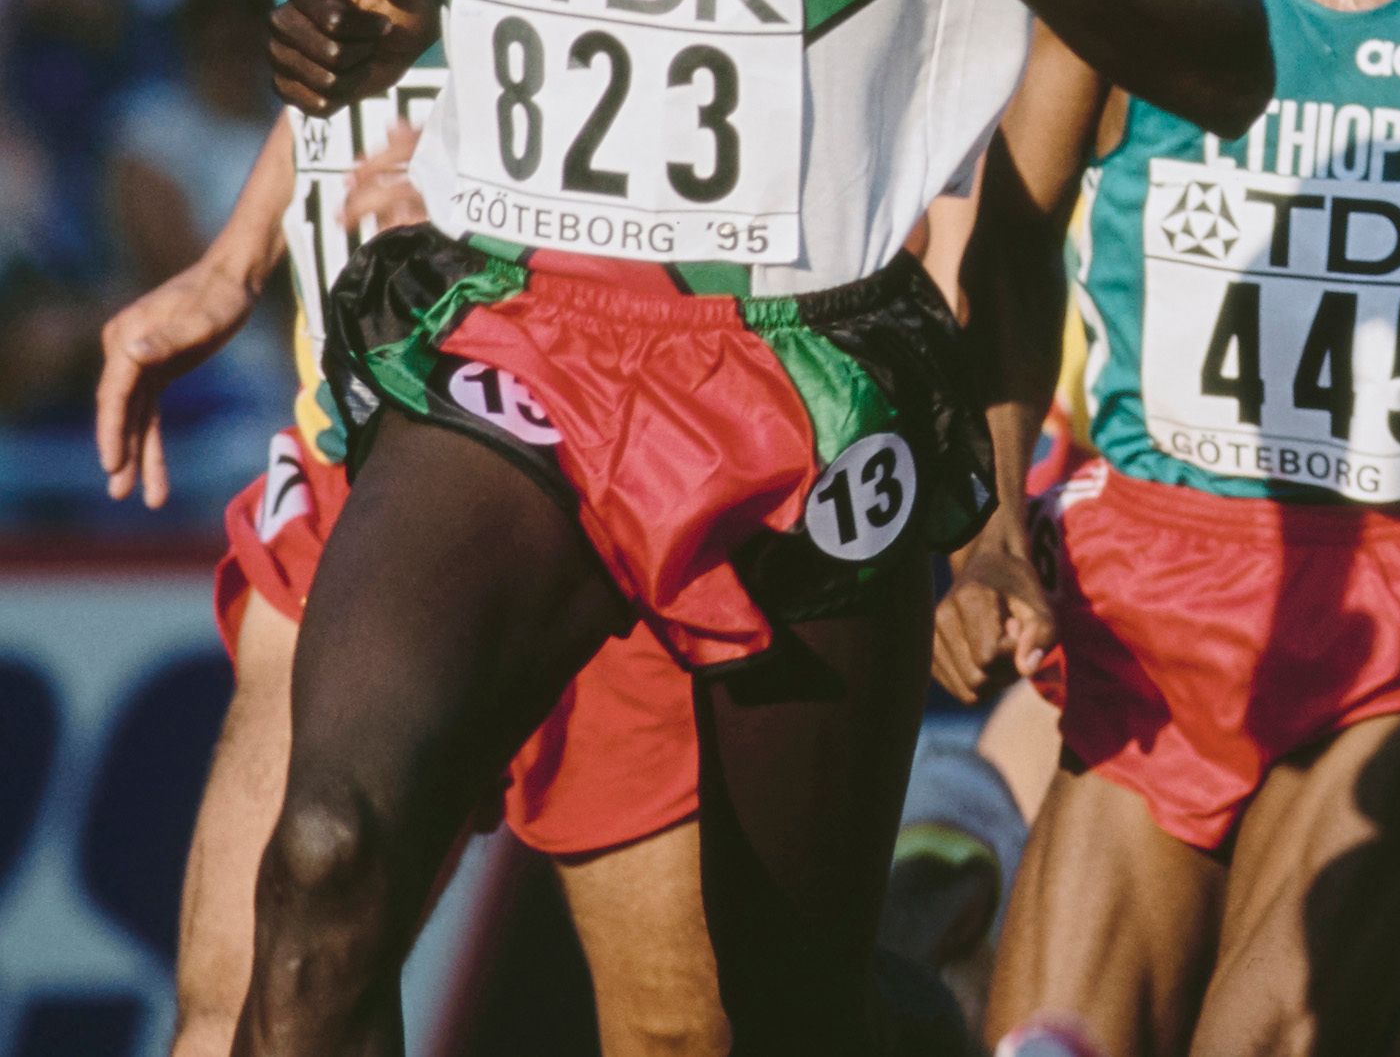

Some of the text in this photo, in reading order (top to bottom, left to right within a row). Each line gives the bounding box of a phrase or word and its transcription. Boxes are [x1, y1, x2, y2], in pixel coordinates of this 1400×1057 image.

[491, 15, 742, 204] 823
[466, 192, 675, 254] GÖTEBORG
[818, 448, 906, 546] 13
[1171, 434, 1382, 493] GÖTEBORG
